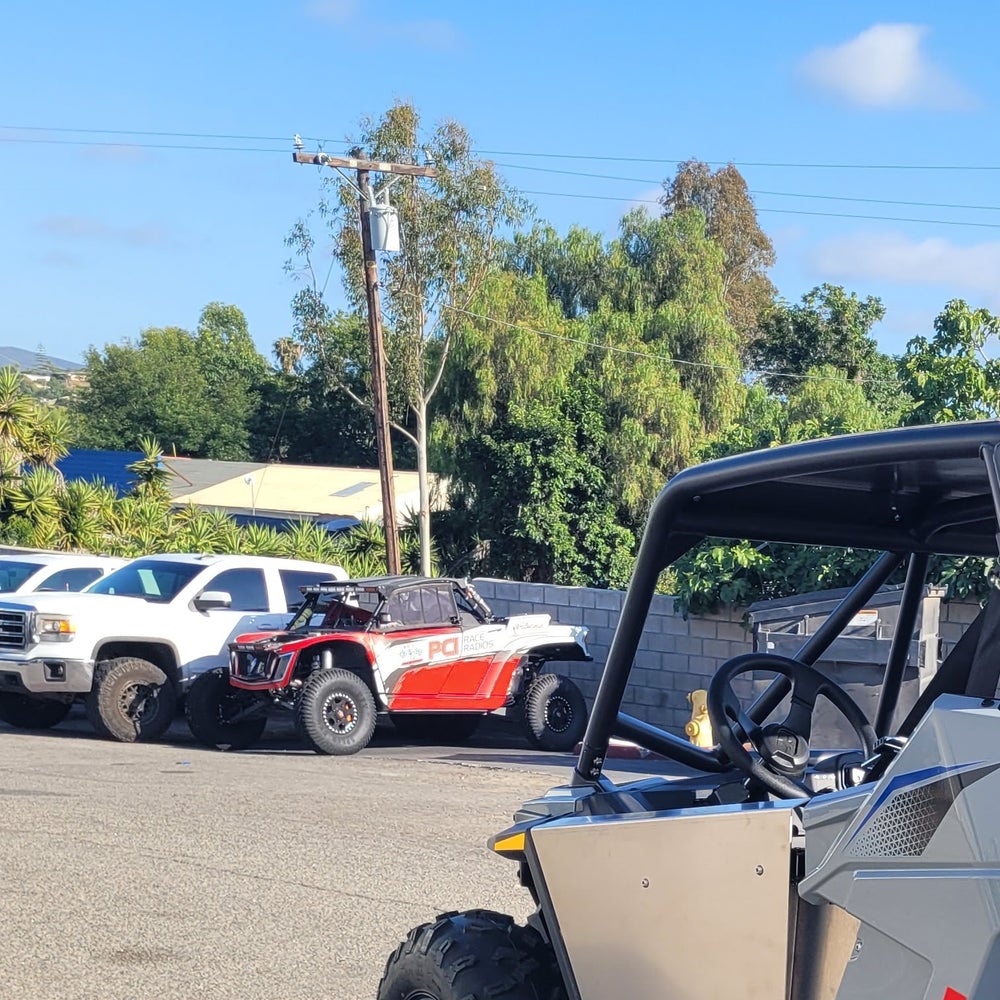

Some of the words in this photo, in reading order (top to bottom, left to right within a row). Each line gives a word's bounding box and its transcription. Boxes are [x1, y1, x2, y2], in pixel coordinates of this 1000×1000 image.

[464, 634, 485, 643] RACE
[429, 638, 459, 660] PCI
[464, 640, 494, 652] RADIOS
